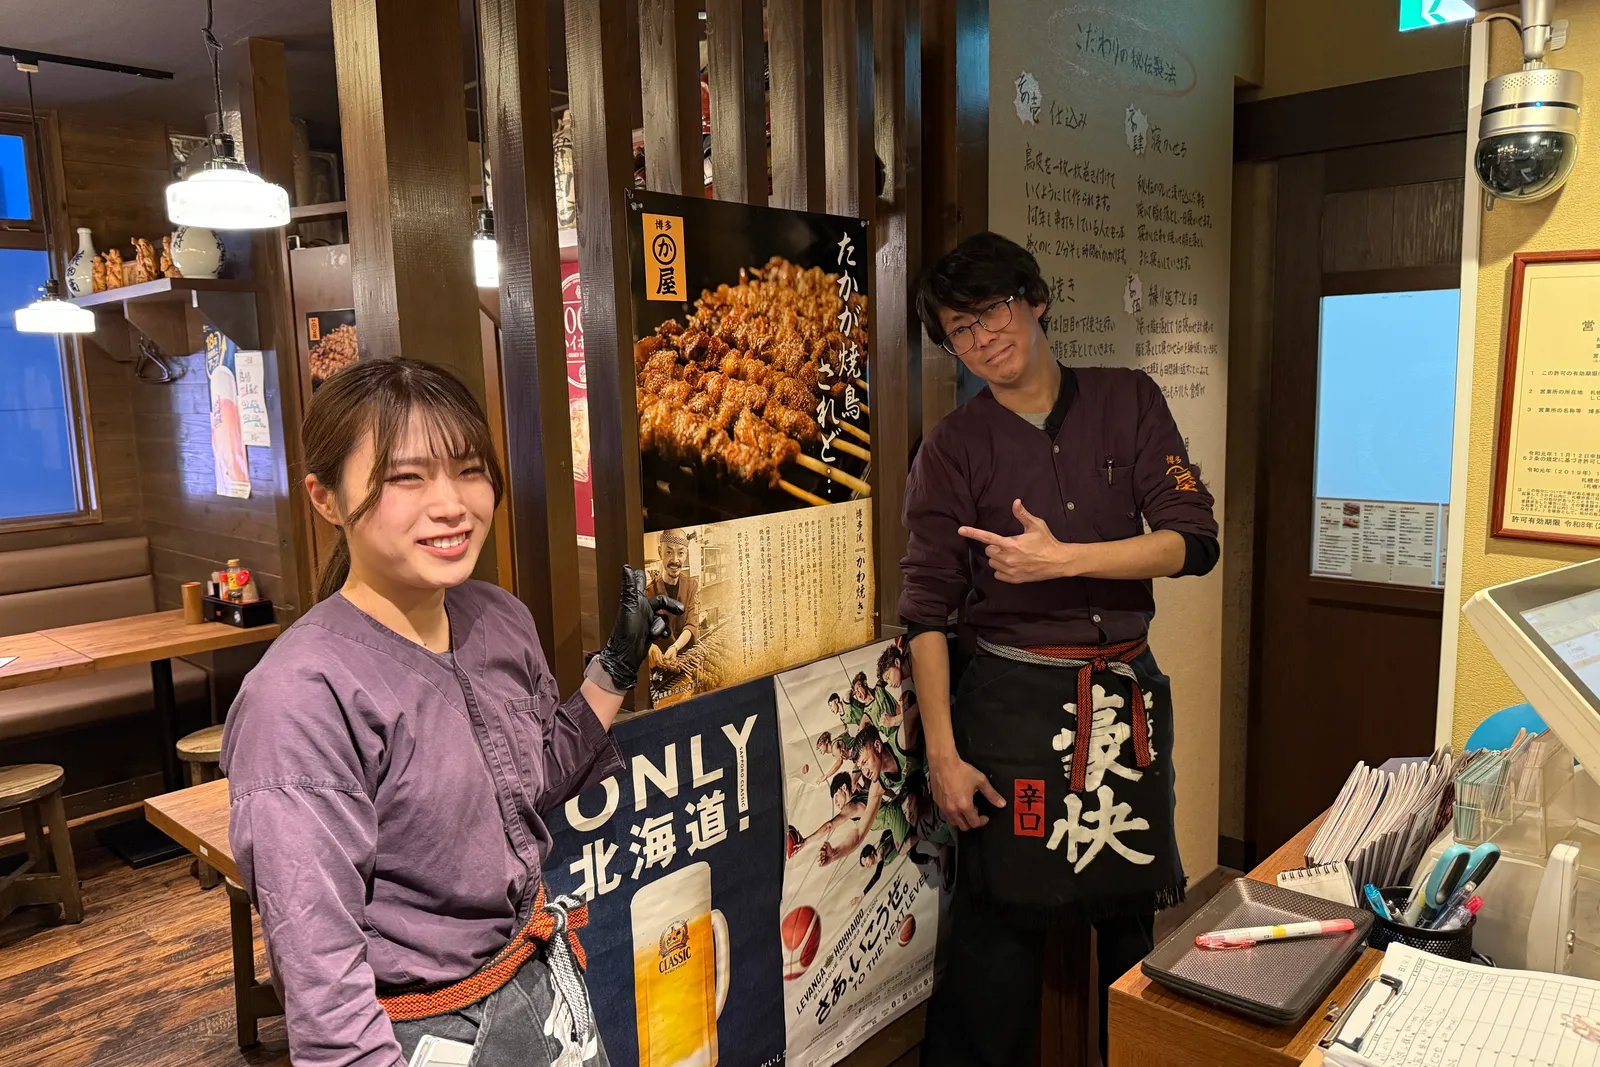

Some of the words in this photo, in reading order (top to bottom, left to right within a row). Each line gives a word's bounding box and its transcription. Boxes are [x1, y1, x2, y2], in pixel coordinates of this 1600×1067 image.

[1075, 23, 1177, 86] こだわりの秘伝製法
[1050, 100, 1088, 130] 仕込み
[1151, 125, 1187, 158] 寝かせる
[1025, 181, 1111, 212] いくようにして作られます。
[655, 219, 673, 231] 博多
[836, 231, 862, 421] たかが焼鳥
[1511, 515, 1561, 527] 許可有効期限
[564, 714, 758, 833] ONLY
[1017, 783, 1043, 831] 辛口
[852, 972, 867, 992] TO
[866, 944, 885, 972] THE
[884, 909, 907, 947] NEXT
[905, 871, 931, 913] LEVEL
[658, 946, 692, 974] CLASSIC
[796, 967, 827, 1016] LEVANGA
[833, 908, 865, 958] HOKKAIDO
